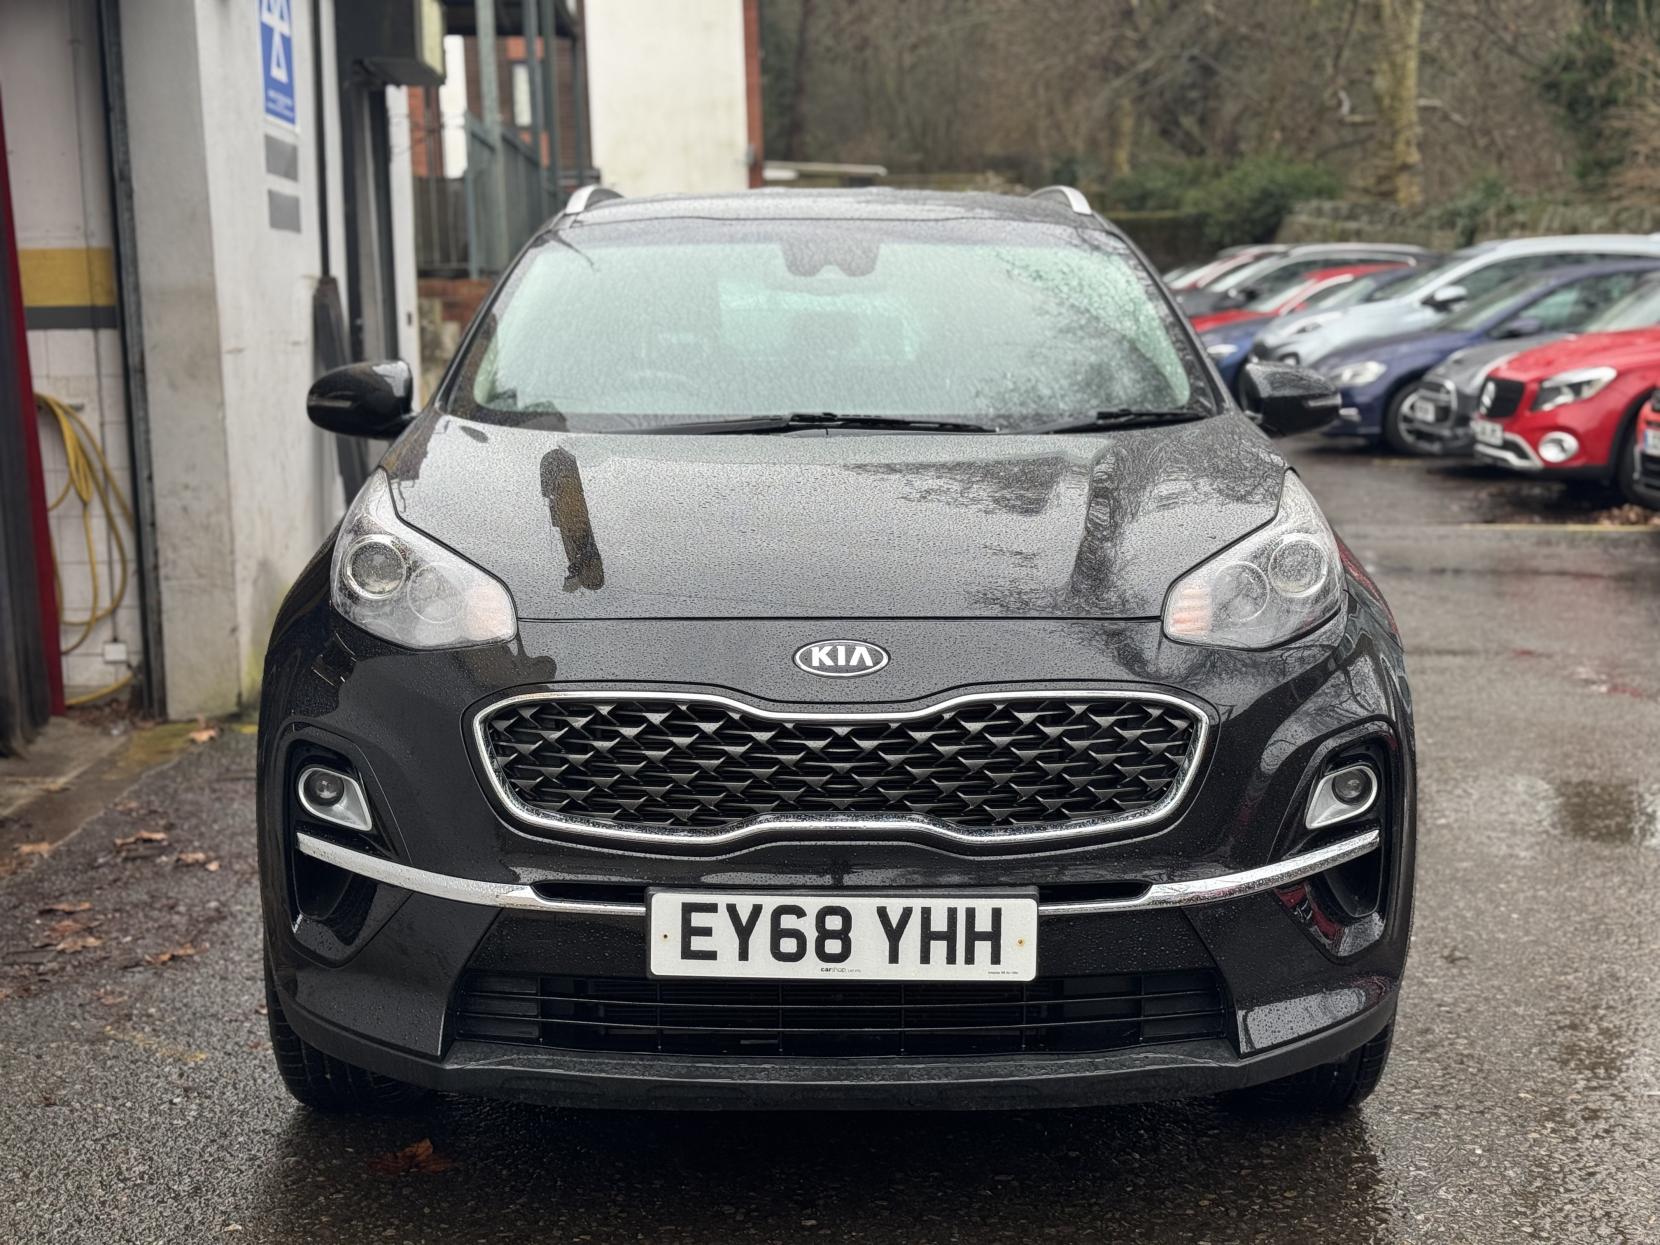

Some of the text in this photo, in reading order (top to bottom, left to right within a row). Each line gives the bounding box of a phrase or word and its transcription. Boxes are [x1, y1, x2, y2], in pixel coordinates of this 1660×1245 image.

[810, 646, 874, 666] KIA
[680, 902, 1002, 966] EY68 YHH
